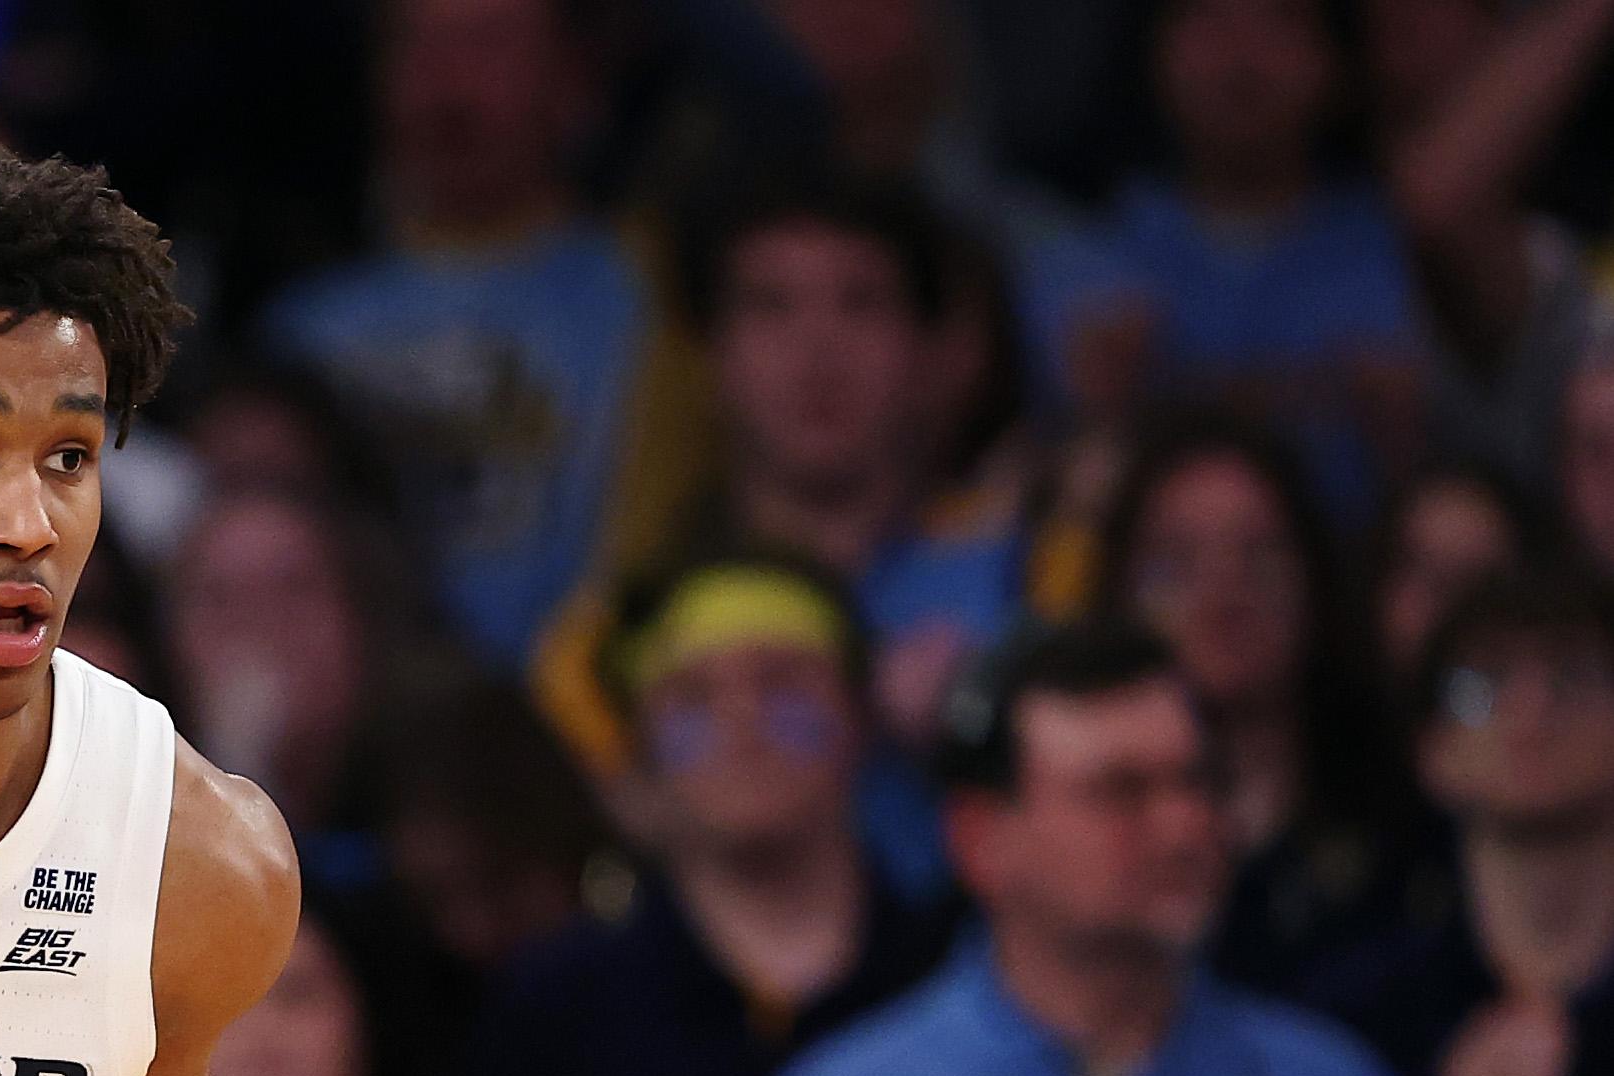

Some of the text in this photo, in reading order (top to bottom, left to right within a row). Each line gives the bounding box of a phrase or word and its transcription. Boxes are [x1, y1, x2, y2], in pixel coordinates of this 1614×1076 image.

[32, 867, 97, 892] BE THE
[23, 888, 95, 914] CHANGE
[16, 927, 76, 948] BIG
[3, 946, 87, 968] EAST
